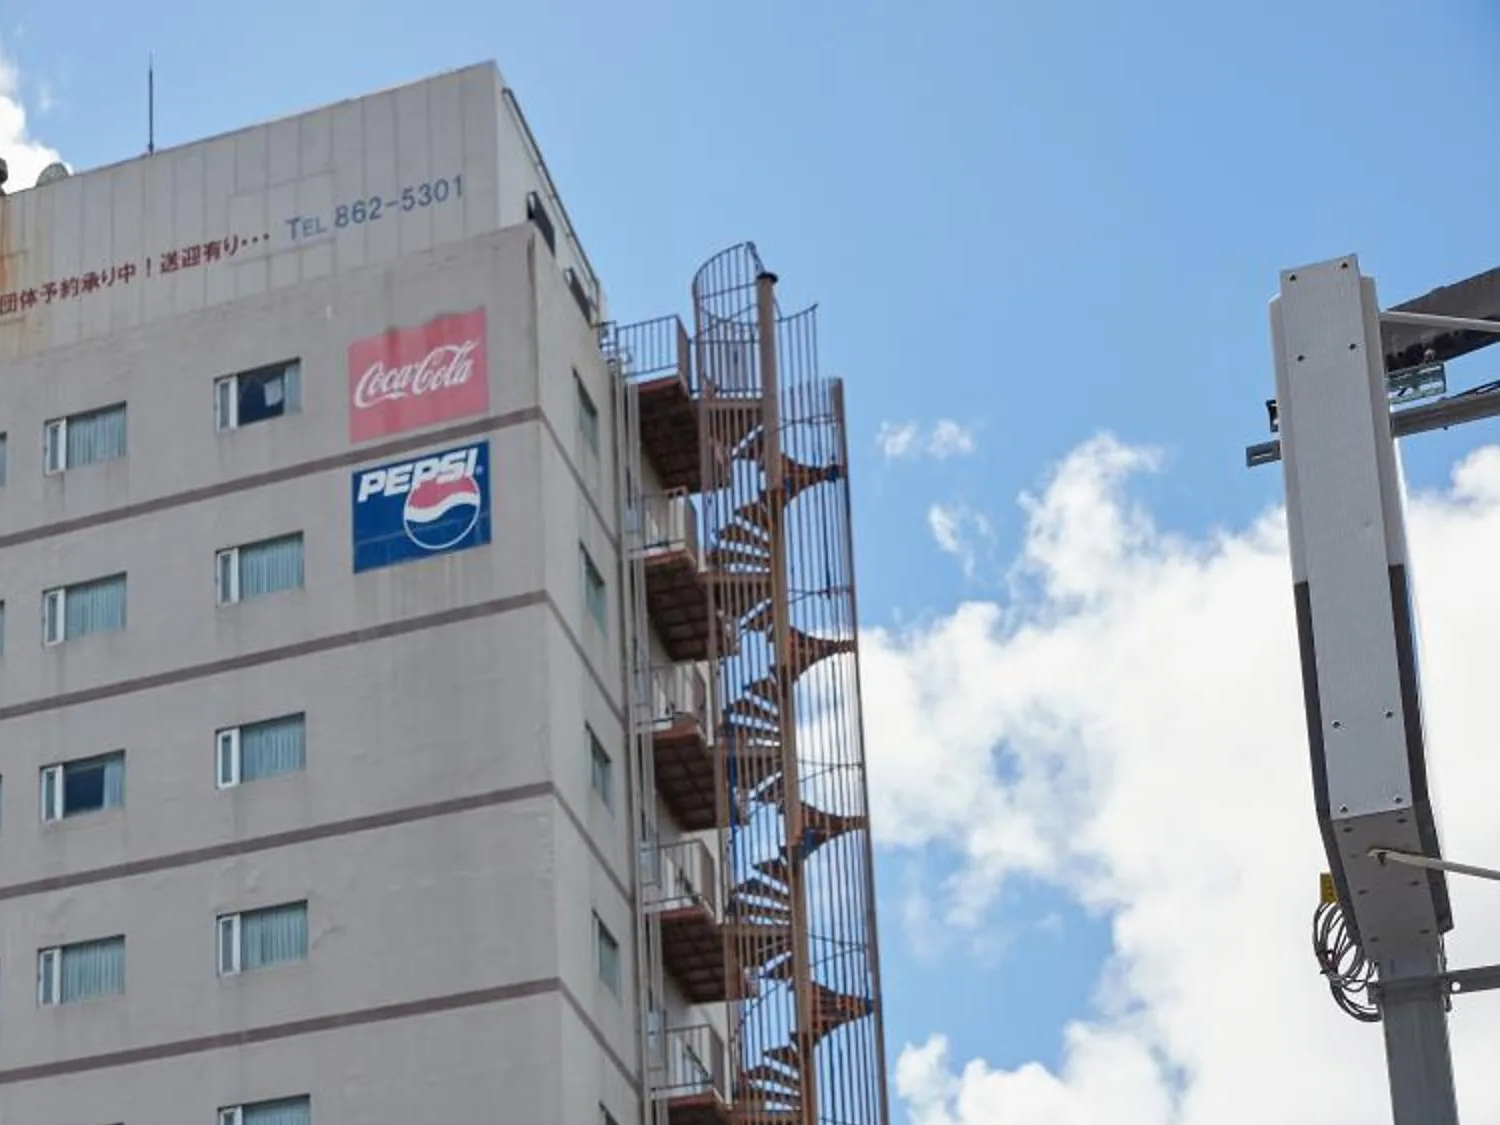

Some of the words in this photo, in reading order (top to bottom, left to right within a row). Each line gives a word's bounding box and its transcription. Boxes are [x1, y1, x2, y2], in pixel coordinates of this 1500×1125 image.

[285, 215, 327, 240] TEL
[334, 175, 466, 230] 862-5301
[357, 447, 479, 503] PEPSI
